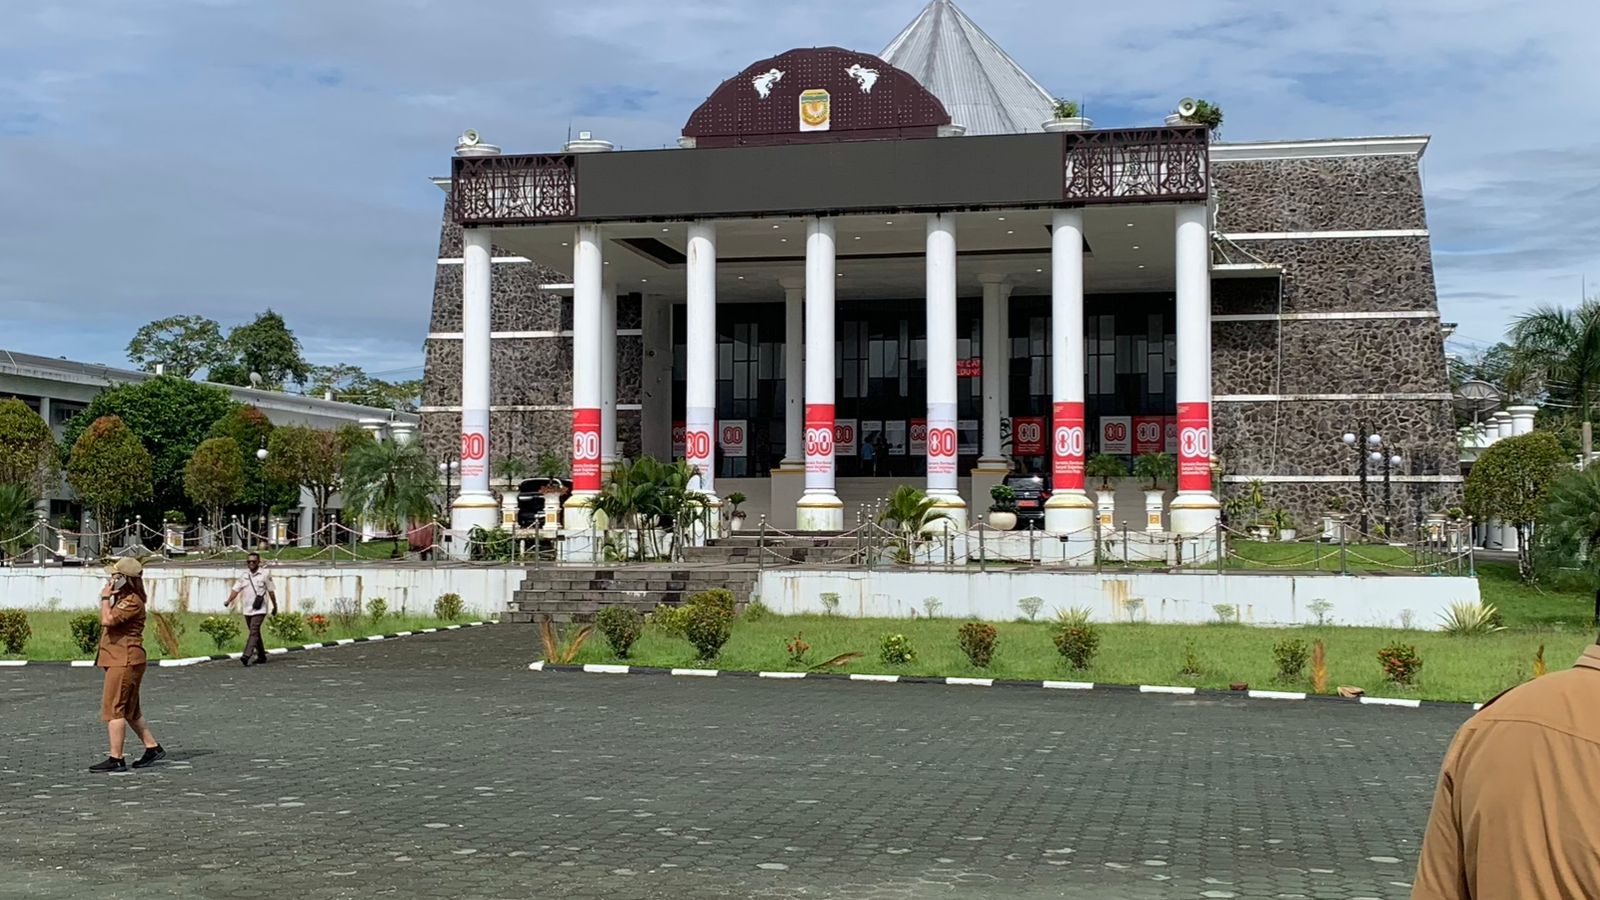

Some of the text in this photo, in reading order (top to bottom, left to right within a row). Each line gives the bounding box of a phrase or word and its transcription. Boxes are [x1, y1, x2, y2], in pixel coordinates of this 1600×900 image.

[723, 426, 743, 444] 80
[929, 428, 956, 457] 80
[1018, 423, 1040, 442] 80
[1055, 426, 1084, 456] 80
[1105, 423, 1126, 441] 80
[1137, 422, 1160, 442] 80
[1181, 427, 1209, 458] 80
[573, 431, 599, 460] 80
